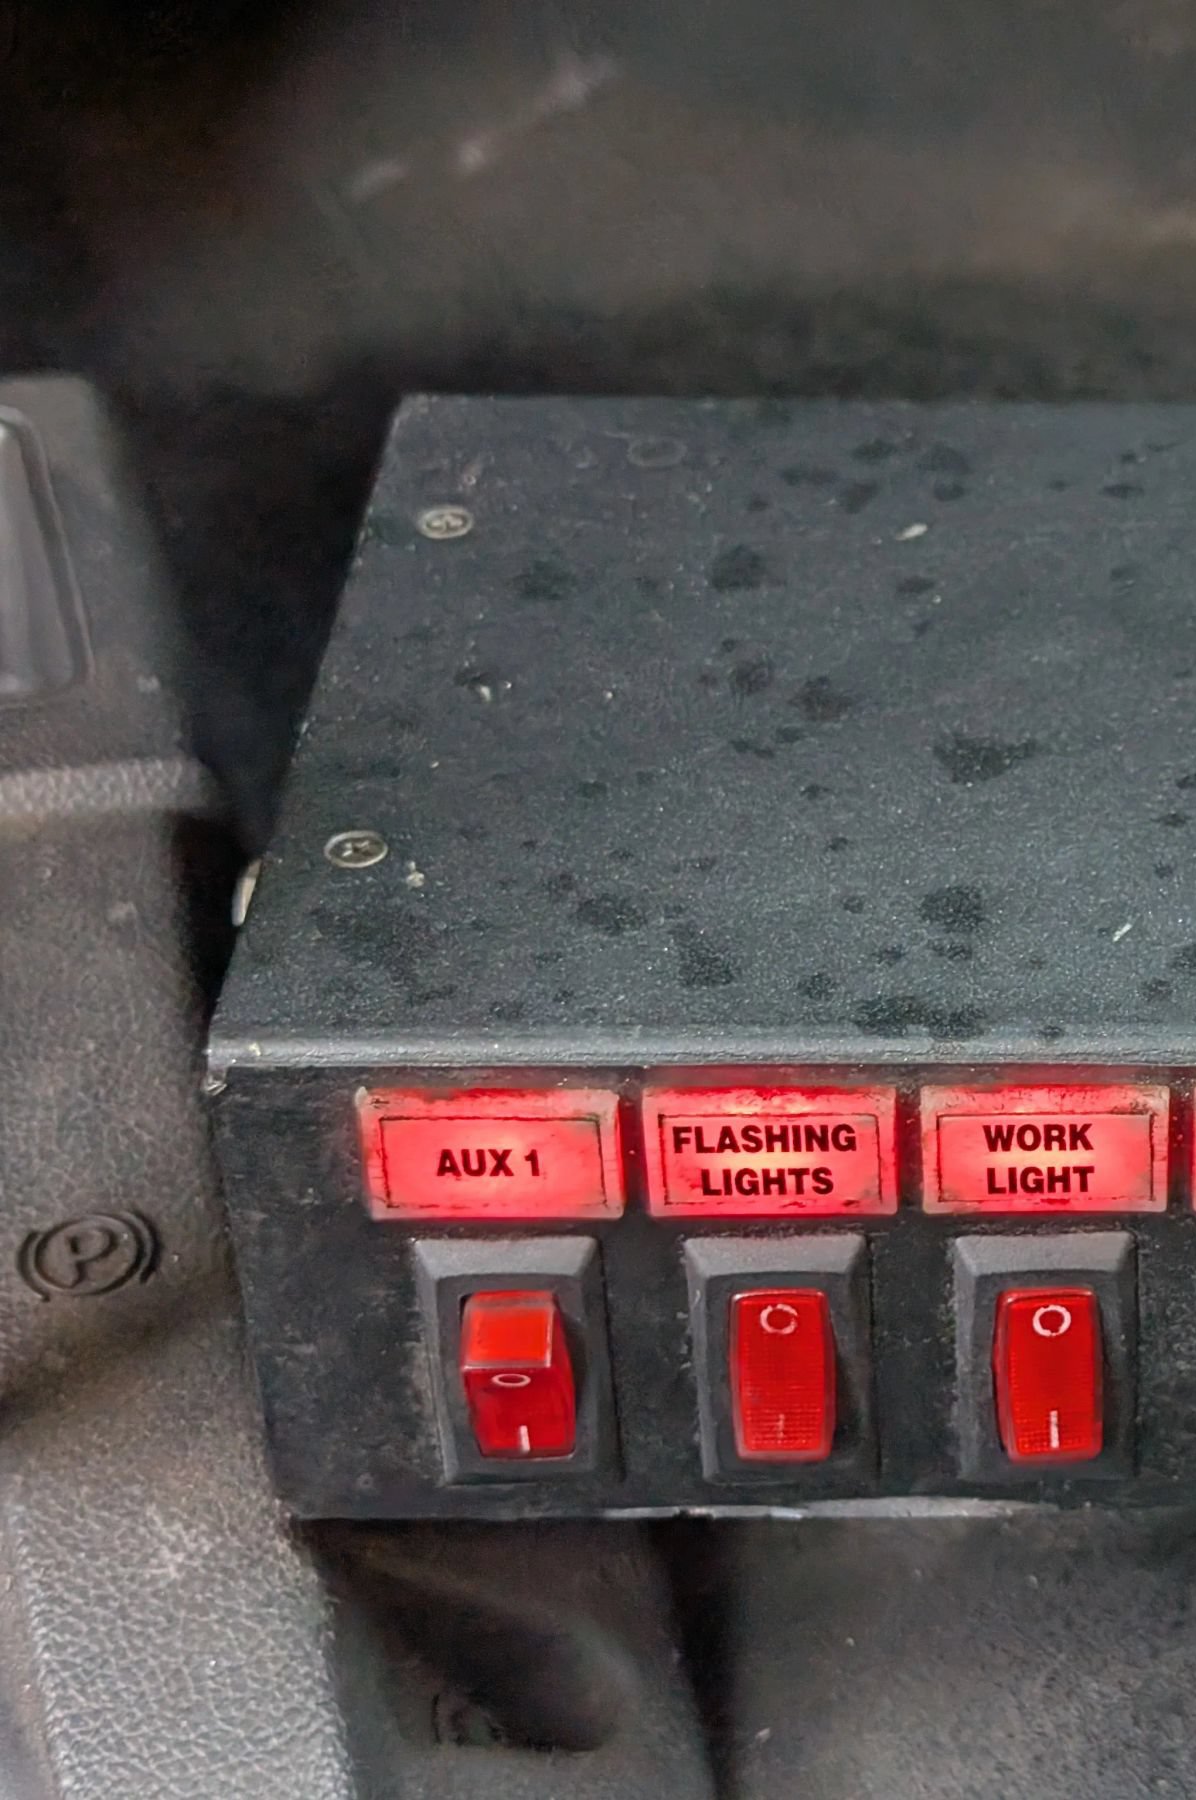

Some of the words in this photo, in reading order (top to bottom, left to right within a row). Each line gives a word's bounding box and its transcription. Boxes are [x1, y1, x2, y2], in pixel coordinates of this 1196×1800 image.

[672, 1124, 857, 1155] FLASHING
[983, 1123, 1094, 1152] WORK
[436, 1149, 513, 1178] AUX
[524, 1149, 541, 1177] 1
[701, 1168, 834, 1196] LIGHTS
[987, 1166, 1095, 1195] LIGHT
